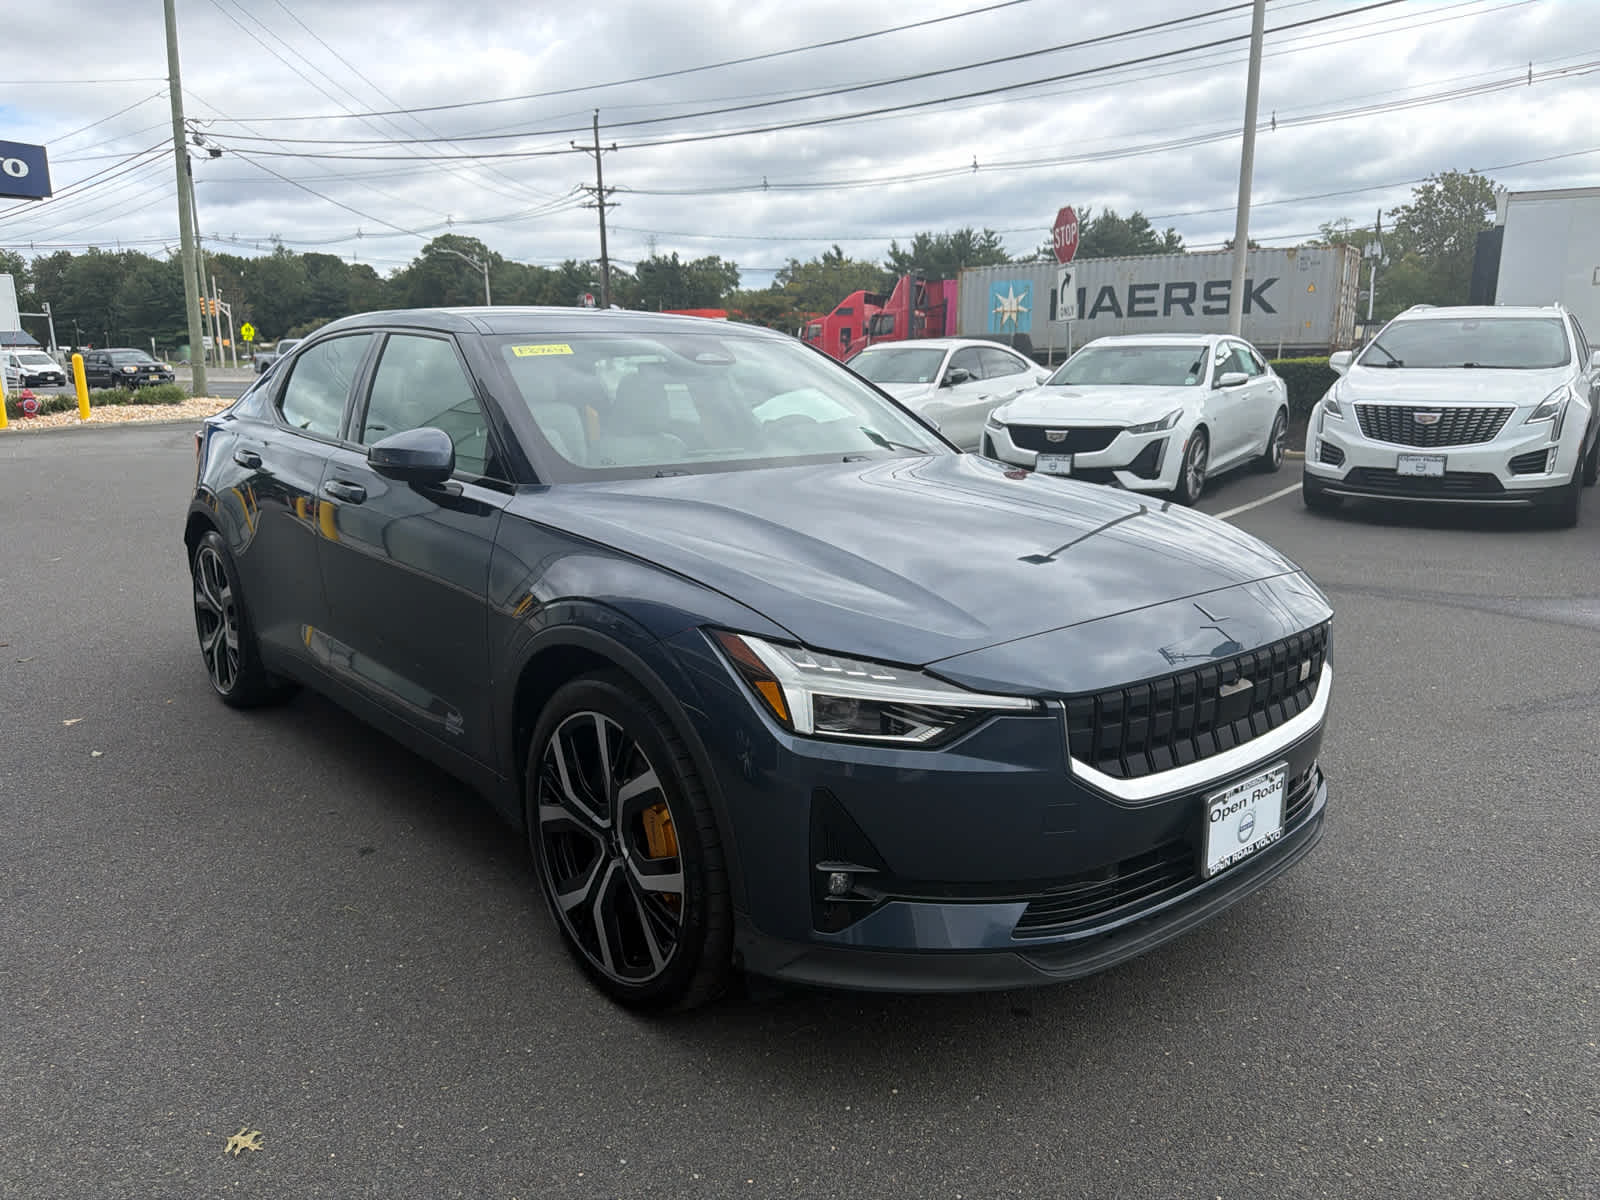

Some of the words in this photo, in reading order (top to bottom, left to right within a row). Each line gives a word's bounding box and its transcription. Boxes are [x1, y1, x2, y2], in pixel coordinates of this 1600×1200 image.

[1054, 223, 1077, 249] STOP
[1060, 304, 1075, 318] ONLY
[1210, 798, 1247, 823] Open
[1252, 776, 1285, 804] Road
[1232, 844, 1254, 863] ROAD
[1255, 831, 1282, 850] VOLVO
